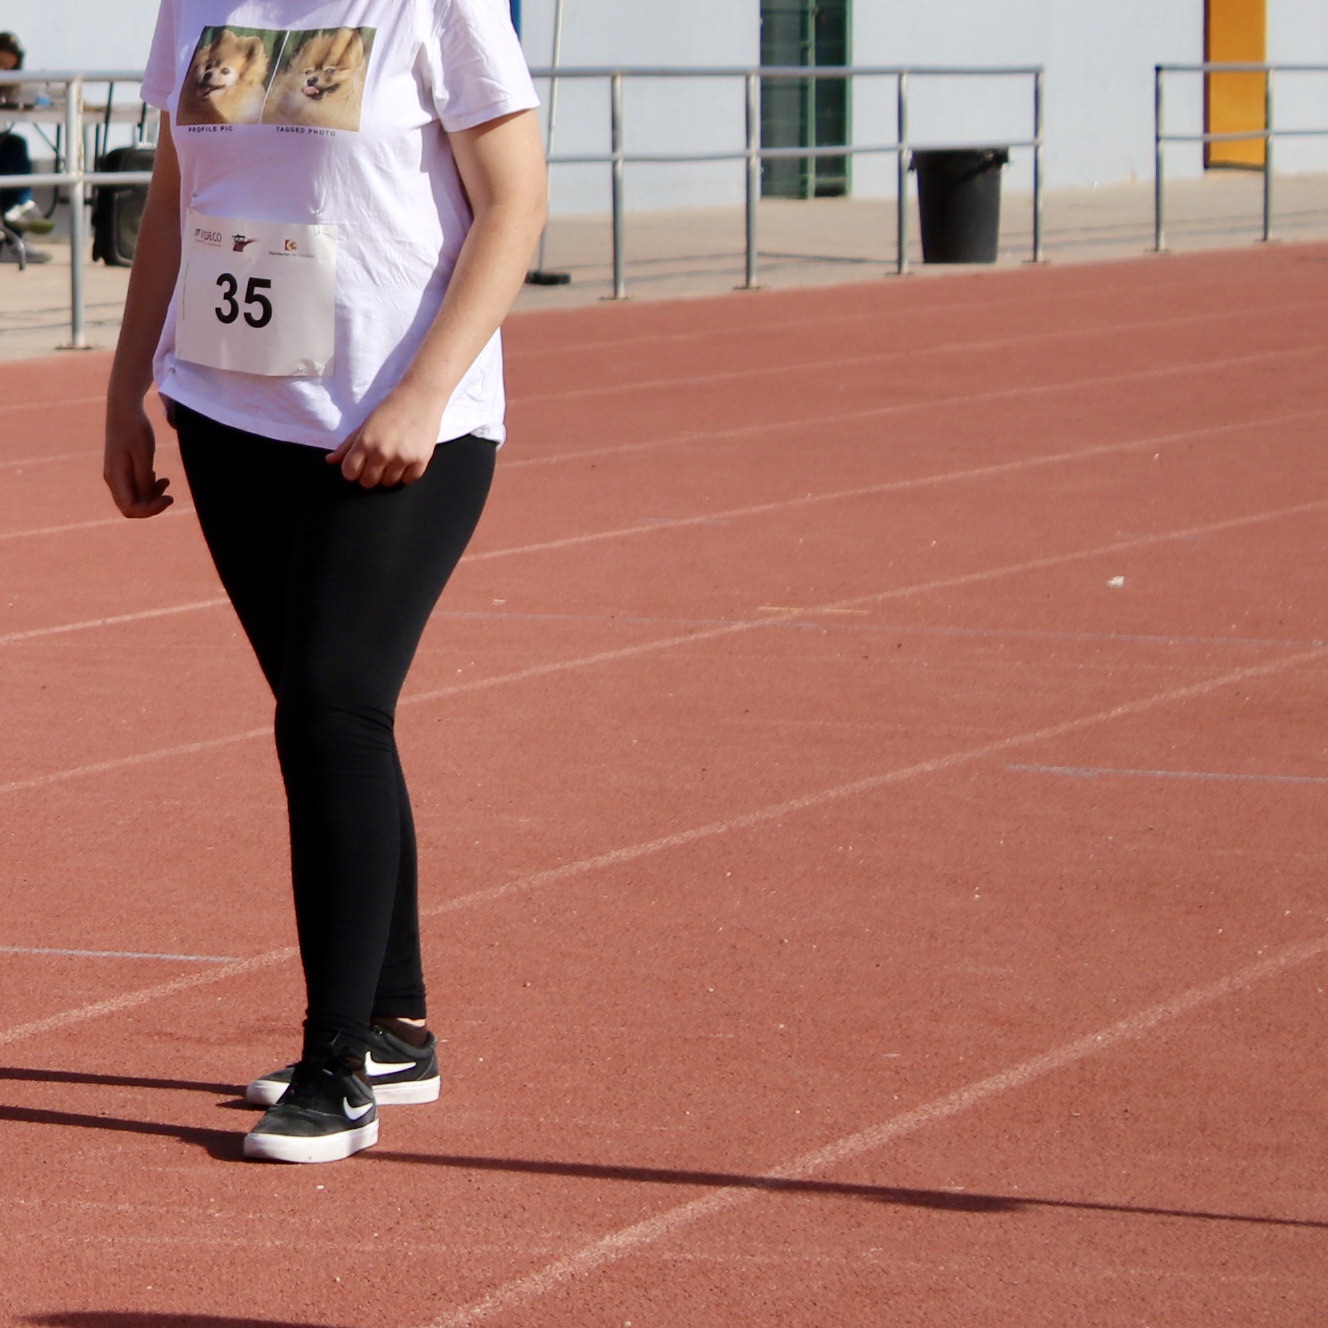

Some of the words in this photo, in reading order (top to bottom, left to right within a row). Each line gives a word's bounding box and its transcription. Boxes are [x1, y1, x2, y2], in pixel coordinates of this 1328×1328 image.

[188, 125, 217, 133] PROFILE
[276, 125, 305, 134] TAGGED
[308, 128, 336, 137] PHOTO
[215, 272, 273, 329] 35
